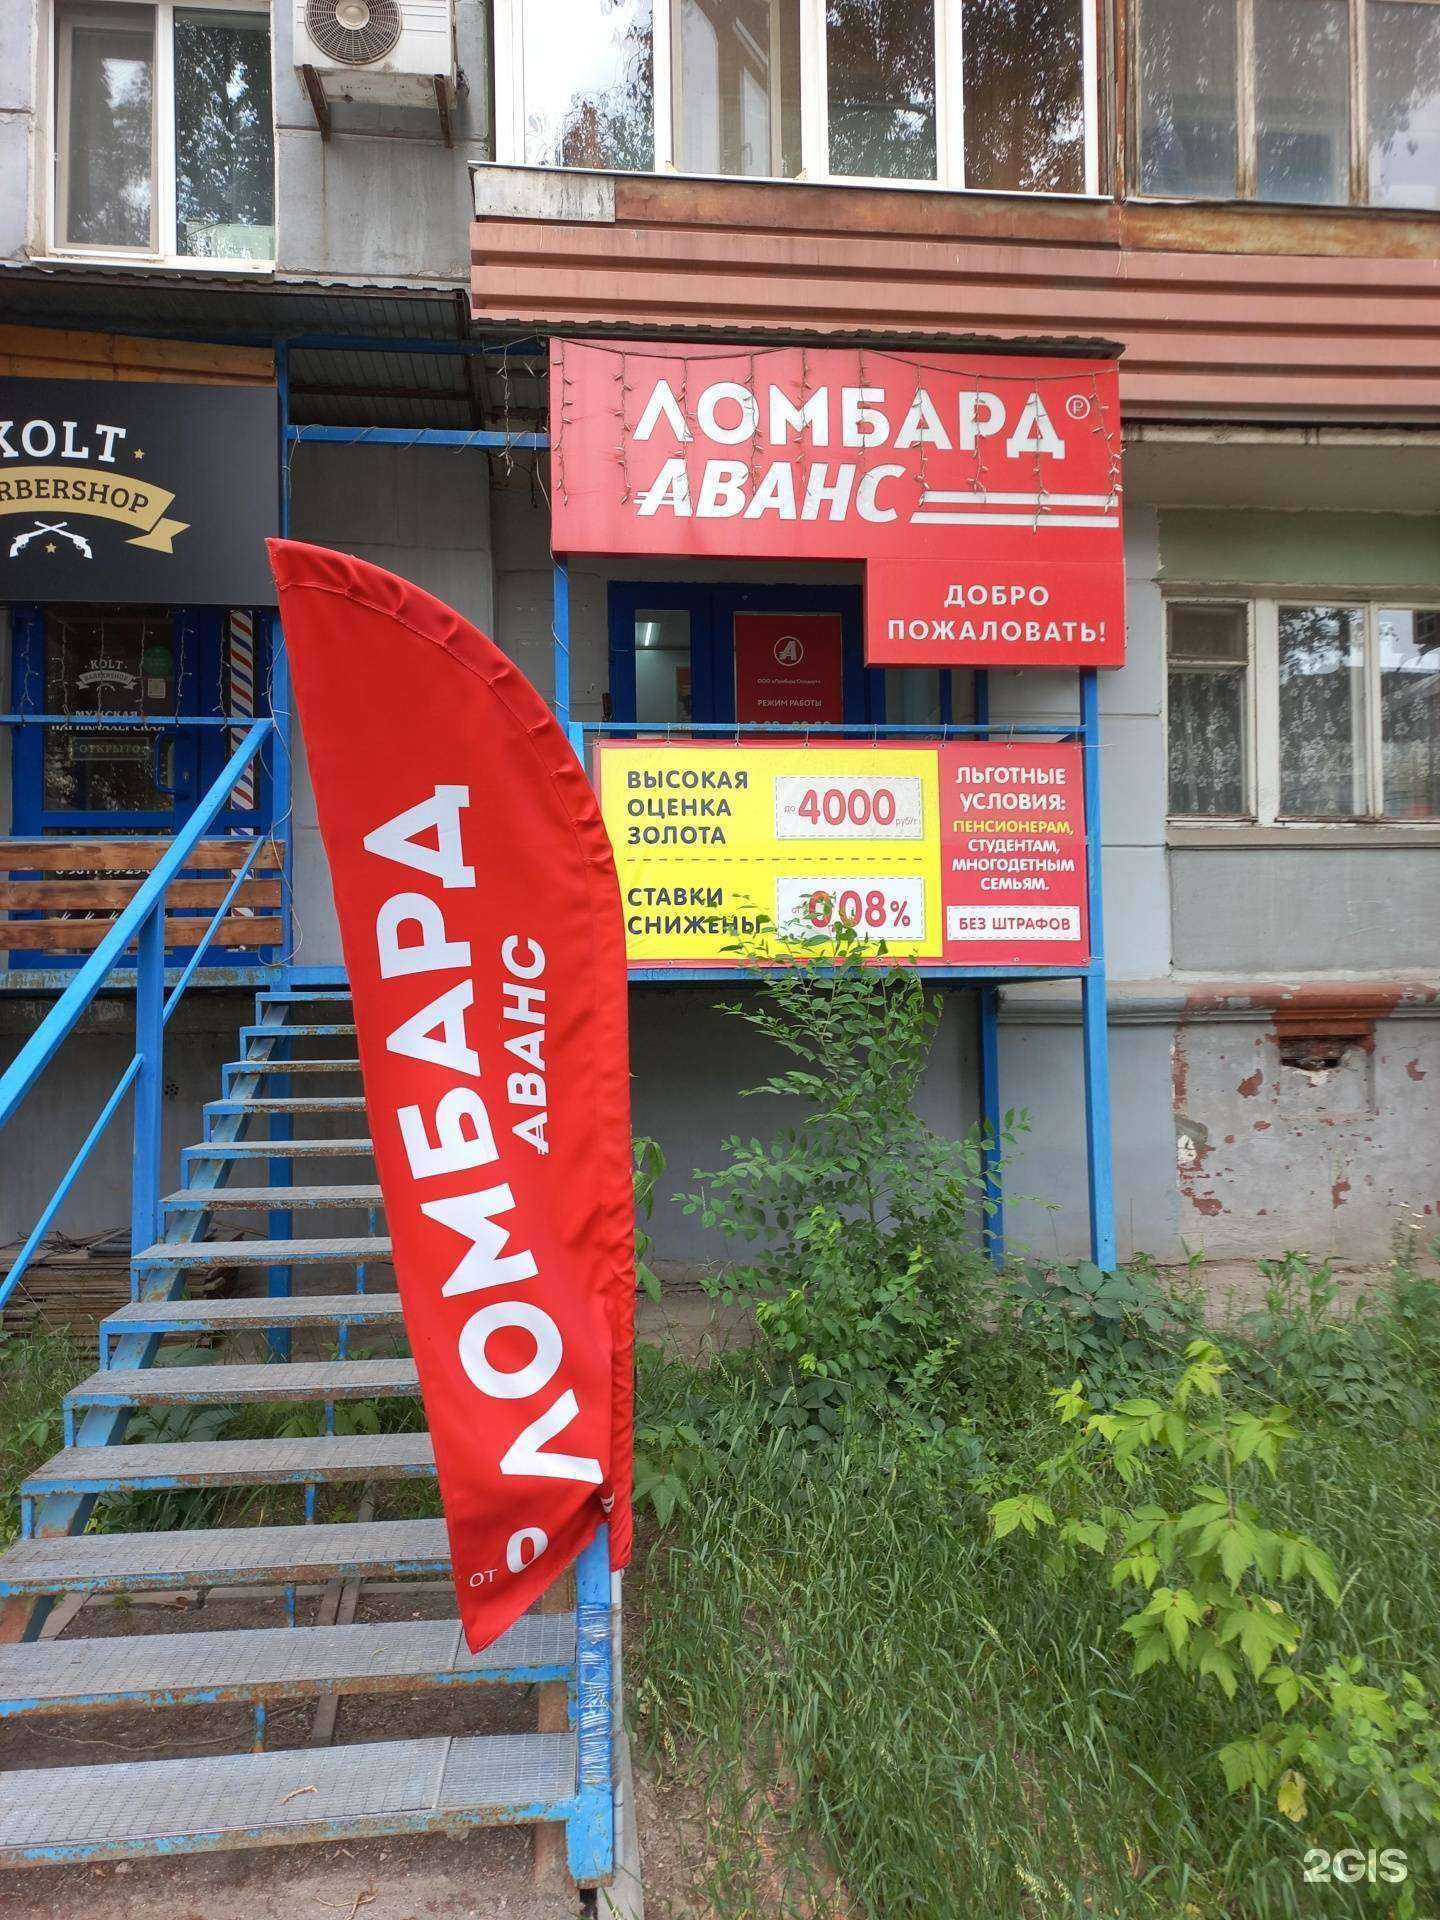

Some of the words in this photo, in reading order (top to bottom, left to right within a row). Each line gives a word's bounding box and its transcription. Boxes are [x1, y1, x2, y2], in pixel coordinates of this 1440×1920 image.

[632, 378, 1066, 460] ЛОМБАРД
[633, 457, 907, 523] АВАНС
[943, 584, 1050, 607] ДОБРО
[887, 618, 1107, 643] ПОЖАЛОВАТЬ!
[757, 699, 788, 707] РЕЖИМ
[789, 699, 822, 707] РАБОТЫ
[627, 771, 748, 789] ВЫСОКАЯ
[955, 766, 1066, 785] ЛЬГОТНЫЕ
[627, 798, 732, 819] ОЦЕНКА
[798, 788, 896, 826] 4000
[960, 792, 1067, 812] УСЛОВИЯ:
[627, 826, 727, 845] ЗОЛОТА
[952, 820, 1075, 836] ПЕНСИОНЕРАМ,
[967, 839, 1061, 855] СТУДЕНТАМ,
[952, 858, 1075, 873] МНОГОДЕТНЫМ
[980, 877, 1051, 891] СЕМЬЯМ.
[627, 887, 724, 907] СТАВКИ
[627, 916, 762, 935] СНИЖЕНЫ
[959, 917, 987, 931] БЕЗ
[992, 917, 1072, 931] ШТРАФОВ
[501, 934, 550, 1155] АВАНС
[363, 784, 604, 1485] ЛОМБАРД
